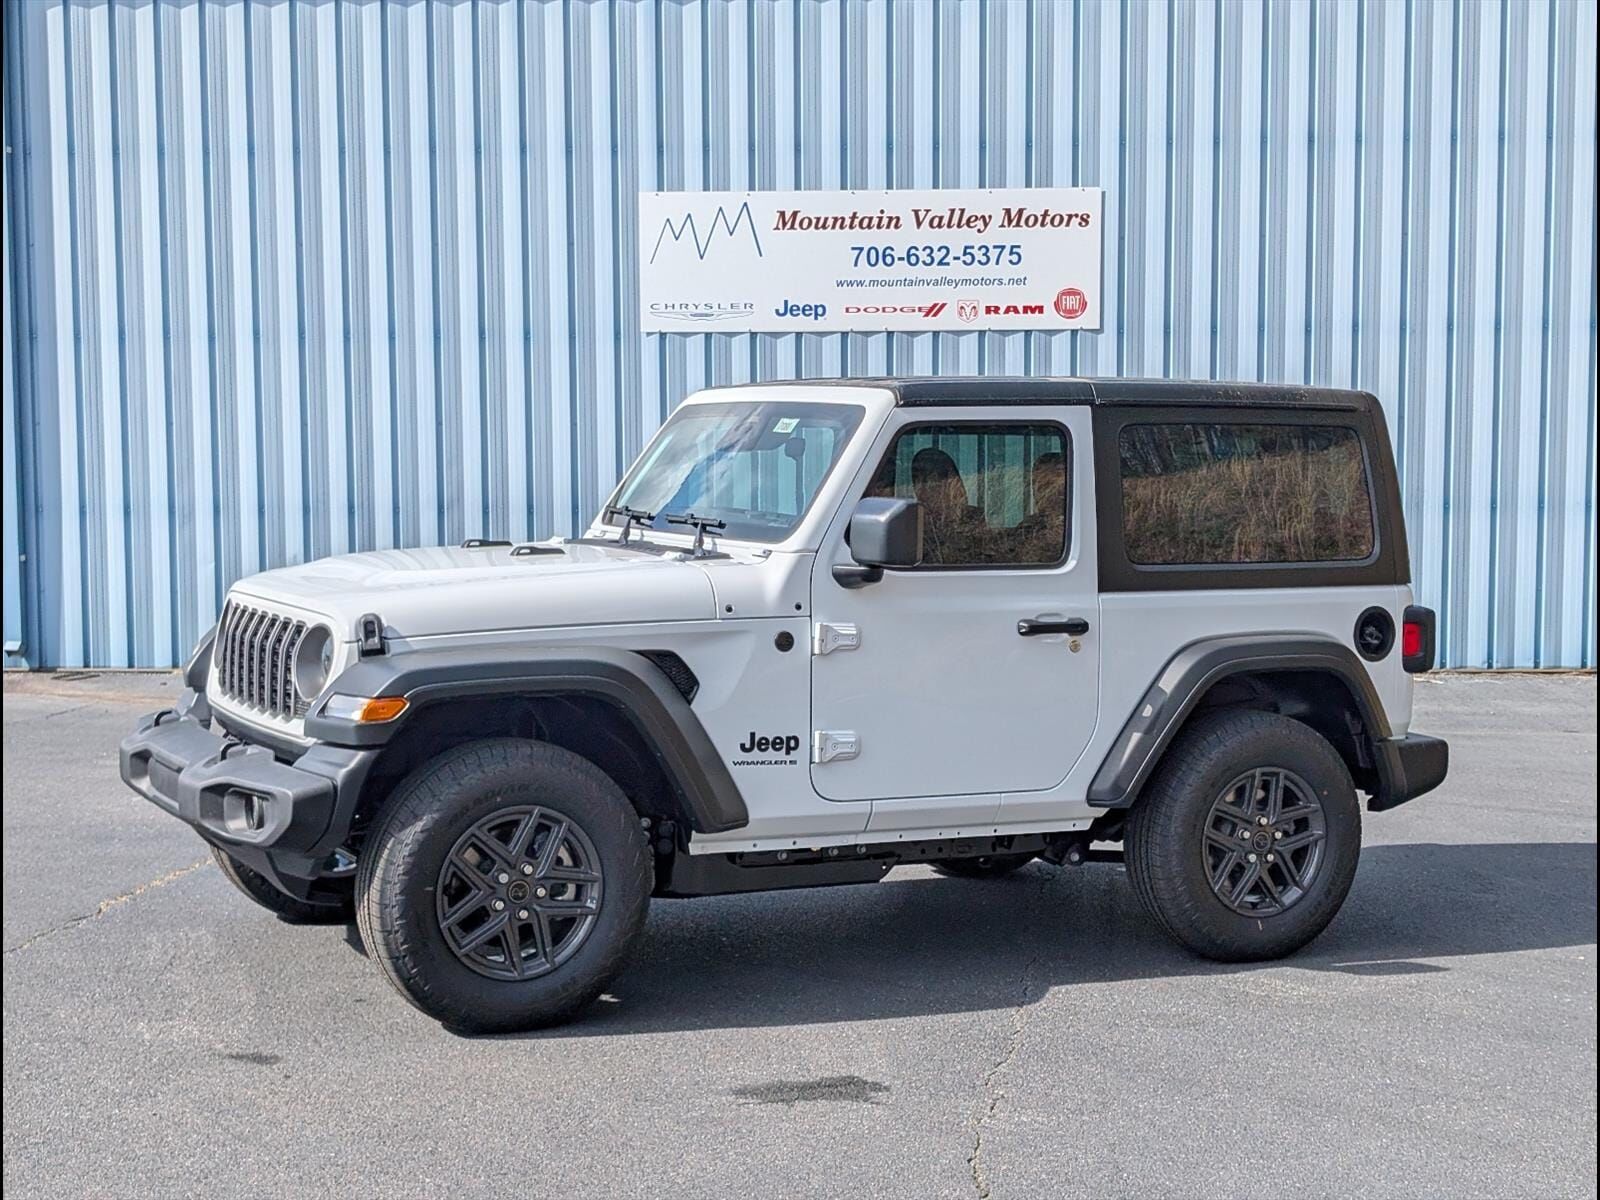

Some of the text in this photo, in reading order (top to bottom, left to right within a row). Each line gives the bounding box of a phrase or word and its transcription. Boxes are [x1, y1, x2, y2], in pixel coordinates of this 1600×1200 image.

[773, 207, 1091, 233] Mountain Valley Motors
[850, 245, 1022, 267] 706-632-5375
[836, 275, 1027, 288] www.mountainvalleymotors.net
[650, 302, 754, 311] CHRYSLER
[775, 300, 827, 320] Jeep
[845, 305, 930, 314] DODGE
[985, 305, 1044, 315] RAM
[1061, 295, 1081, 310] FIAT
[740, 732, 799, 755] Jeep
